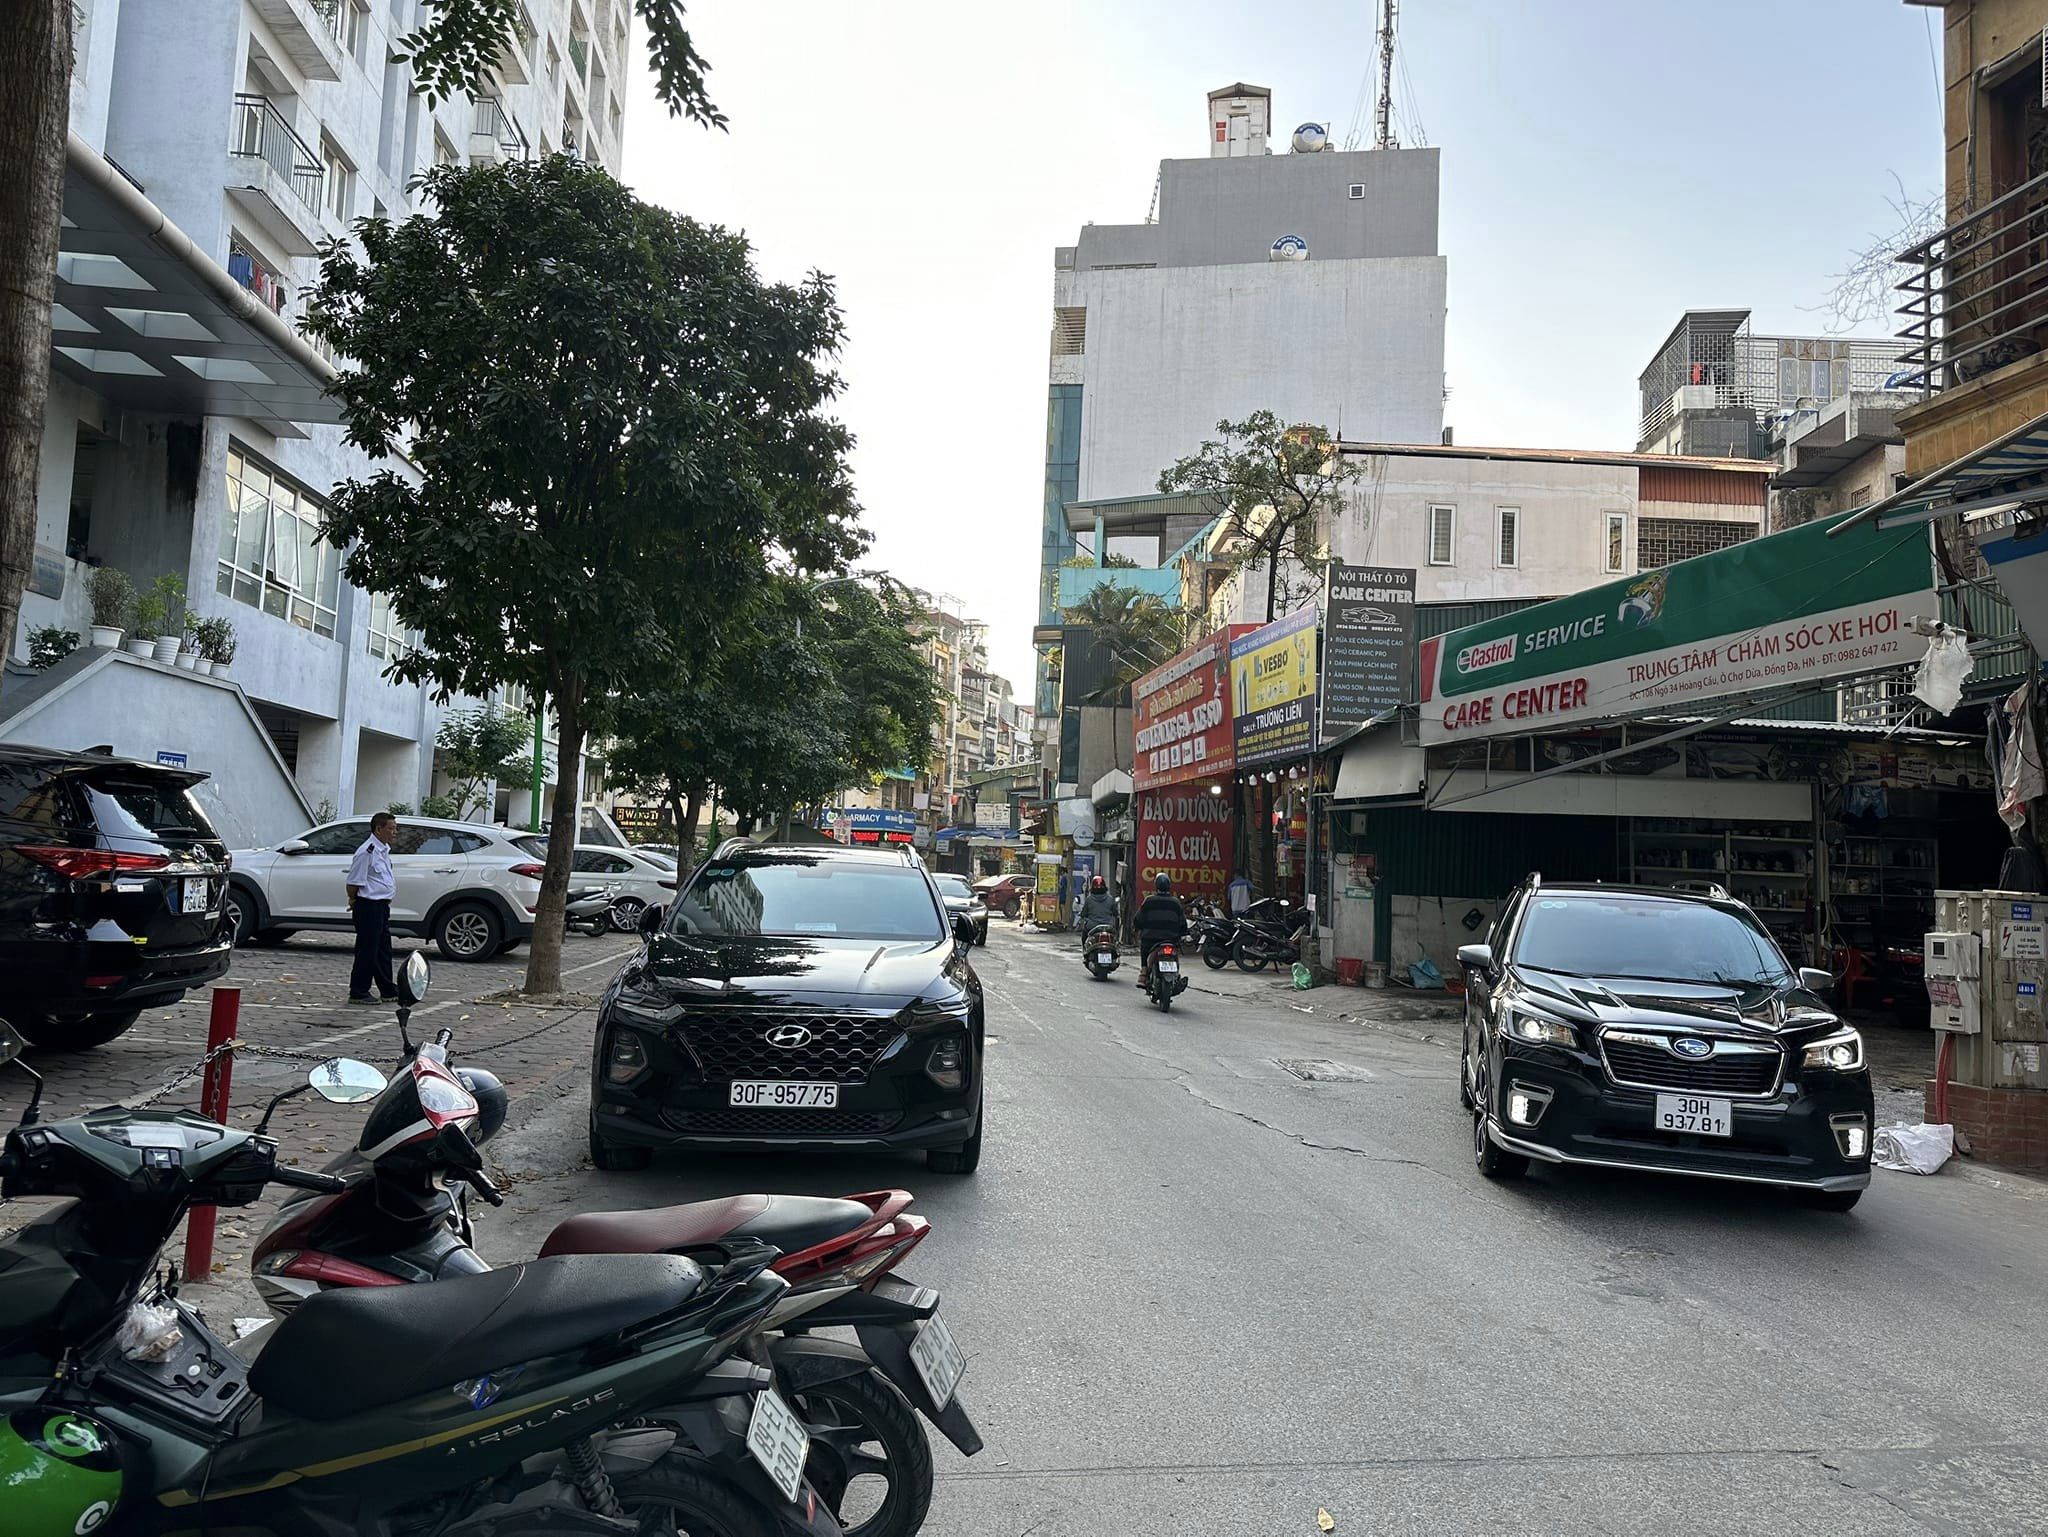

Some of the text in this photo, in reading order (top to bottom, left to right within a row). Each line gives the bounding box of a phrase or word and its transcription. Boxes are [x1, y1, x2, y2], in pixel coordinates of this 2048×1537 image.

[1338, 570, 1407, 584] NỘI THẤT Ô TÔ
[1331, 586, 1412, 603] CARE CENTER
[1471, 614, 1606, 668] Castrol SERVICE
[1627, 609, 1898, 684] TRUNG TÂM CHĂM SÓC XE HƠI
[1264, 650, 1288, 674] VESBO
[1670, 684, 1678, 692] 34
[1802, 657, 1816, 668] HN
[1838, 648, 1860, 661] 0982
[1862, 645, 1878, 656] 647
[1880, 641, 1898, 652] 472
[1286, 700, 1302, 722] LIÊN
[1443, 678, 1588, 730] CARE CENTER
[1144, 790, 1231, 823] BẢO DƯỠNG
[1146, 826, 1221, 861] SỬA CHỮA
[732, 1084, 835, 1105] 30F-957.75
[1678, 1098, 1710, 1115] 30H
[1664, 1114, 1722, 1134] 937.81
